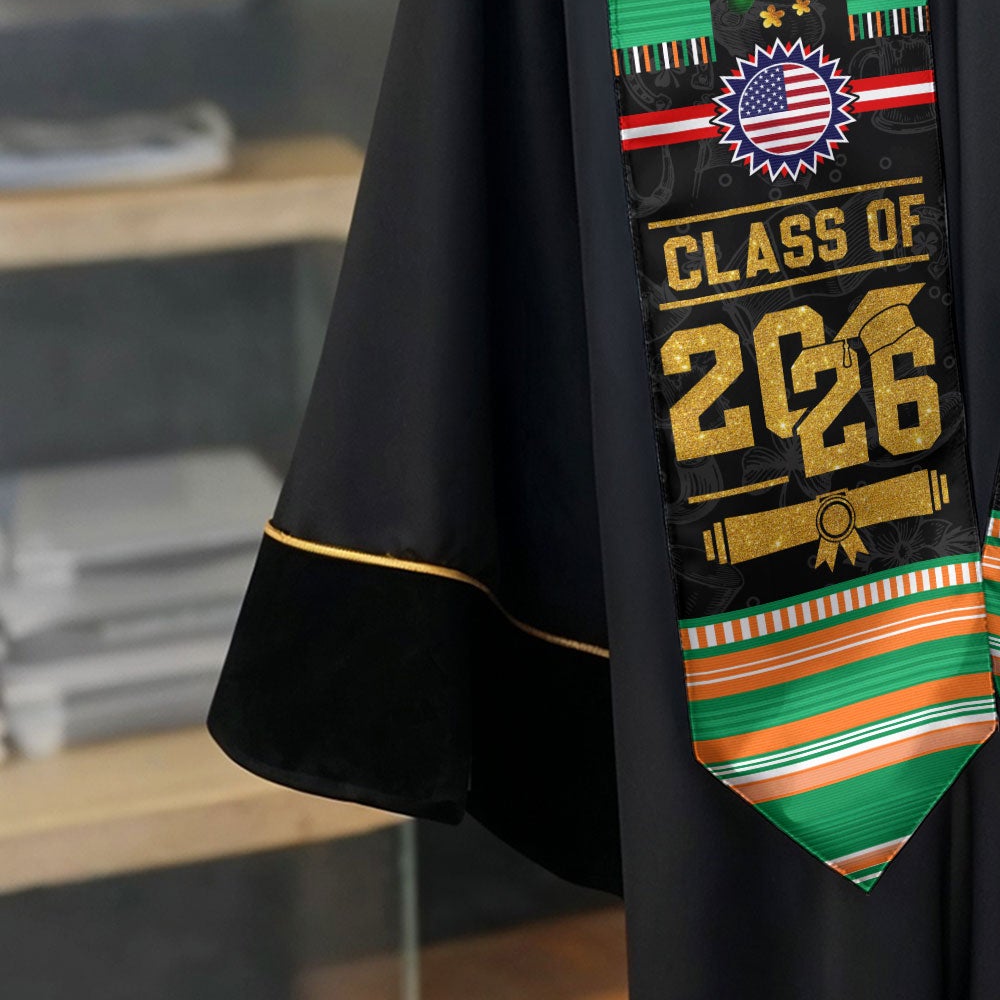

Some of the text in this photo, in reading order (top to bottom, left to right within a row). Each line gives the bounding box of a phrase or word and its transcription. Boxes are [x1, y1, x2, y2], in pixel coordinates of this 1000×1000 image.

[663, 194, 925, 291] CLASS OF
[660, 304, 942, 478] 2026
